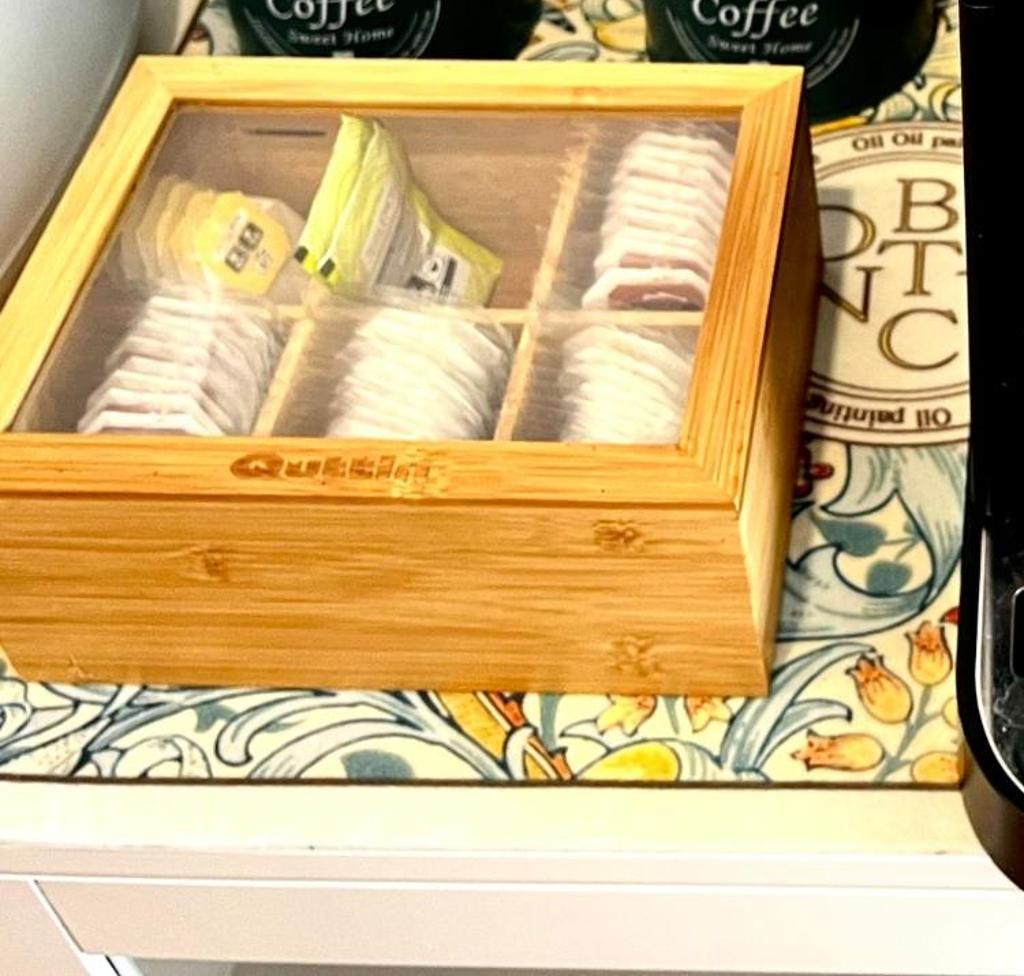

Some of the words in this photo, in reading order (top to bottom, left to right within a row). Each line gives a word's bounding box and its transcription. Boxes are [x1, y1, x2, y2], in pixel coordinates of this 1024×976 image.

[288, 28, 337, 45] Sweet
[707, 34, 756, 54] Sweet
[852, 134, 884, 152] Oil
[892, 131, 924, 146] Oil
[893, 177, 960, 235] B
[916, 407, 952, 429] Oil
